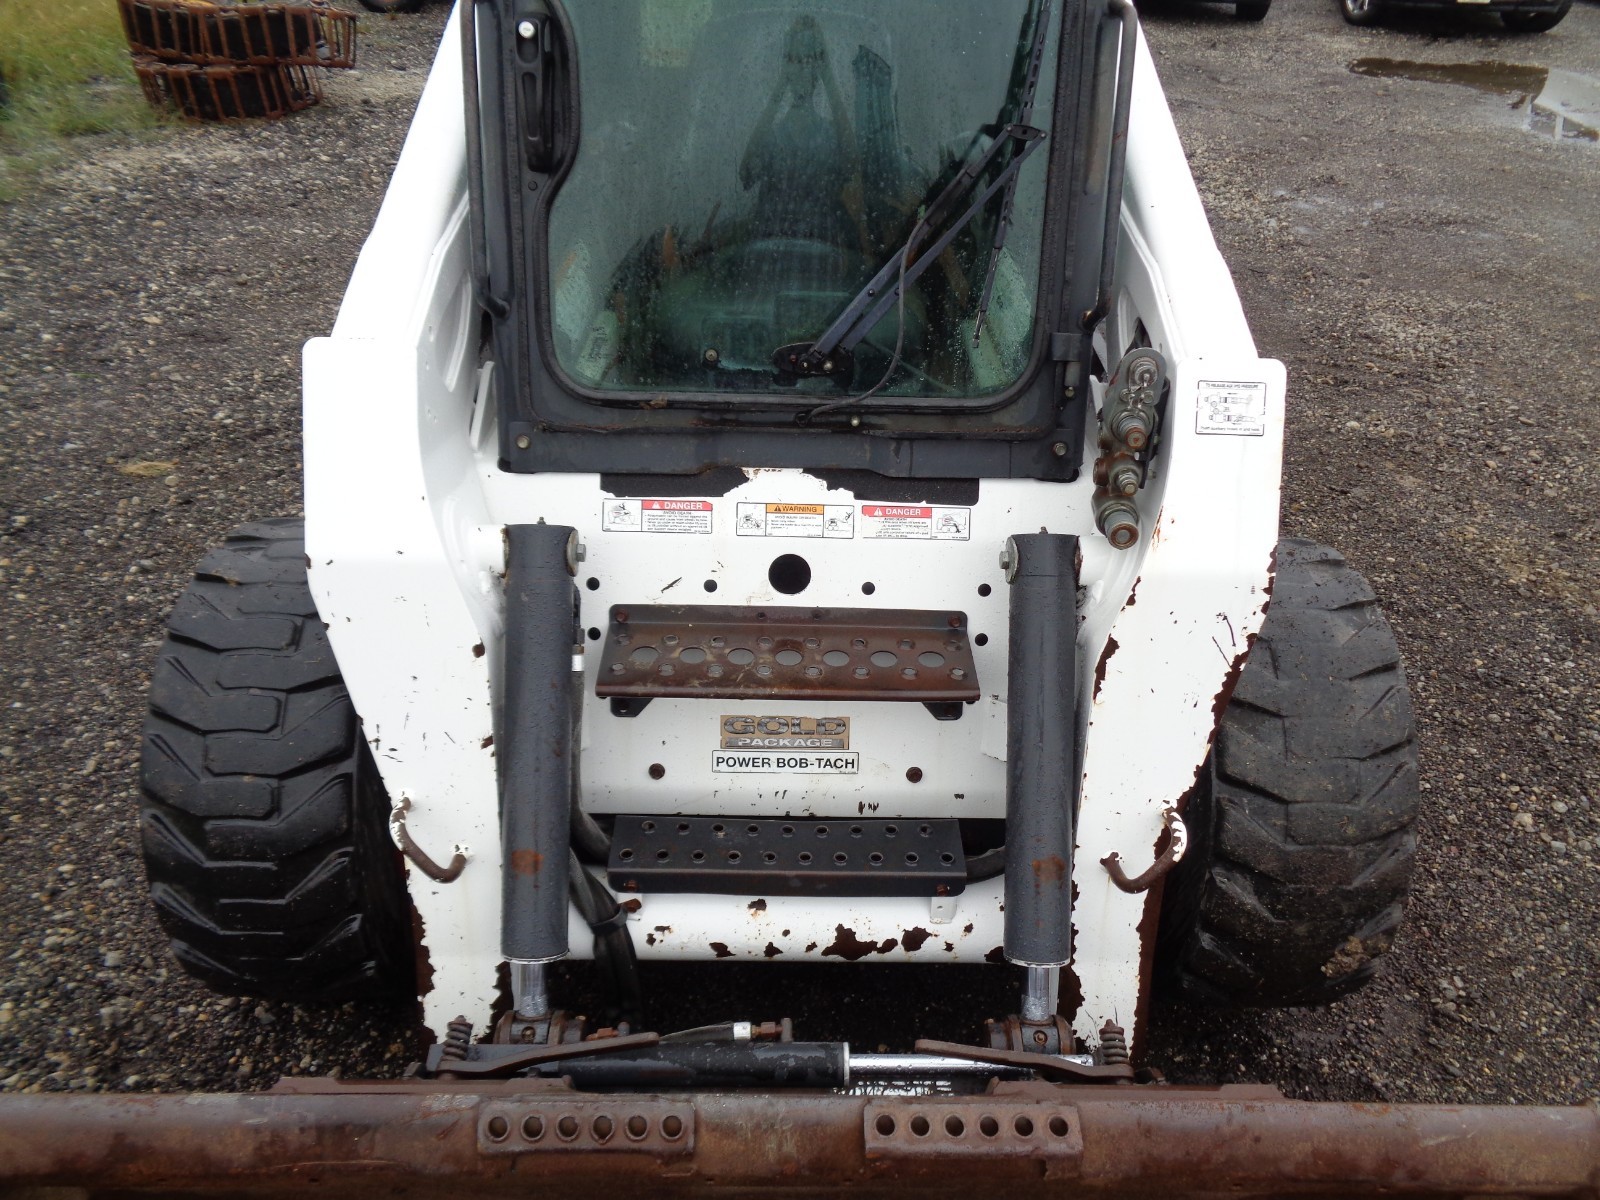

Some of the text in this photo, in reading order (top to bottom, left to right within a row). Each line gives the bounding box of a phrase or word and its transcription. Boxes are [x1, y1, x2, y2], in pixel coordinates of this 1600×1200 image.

[664, 502, 703, 510] DANGER
[782, 505, 817, 513] WARNING
[885, 508, 921, 516] DANGER
[723, 716, 847, 736] GOLD
[737, 737, 833, 747] PACKAGE
[716, 756, 855, 769] POWER BOB-TACH
